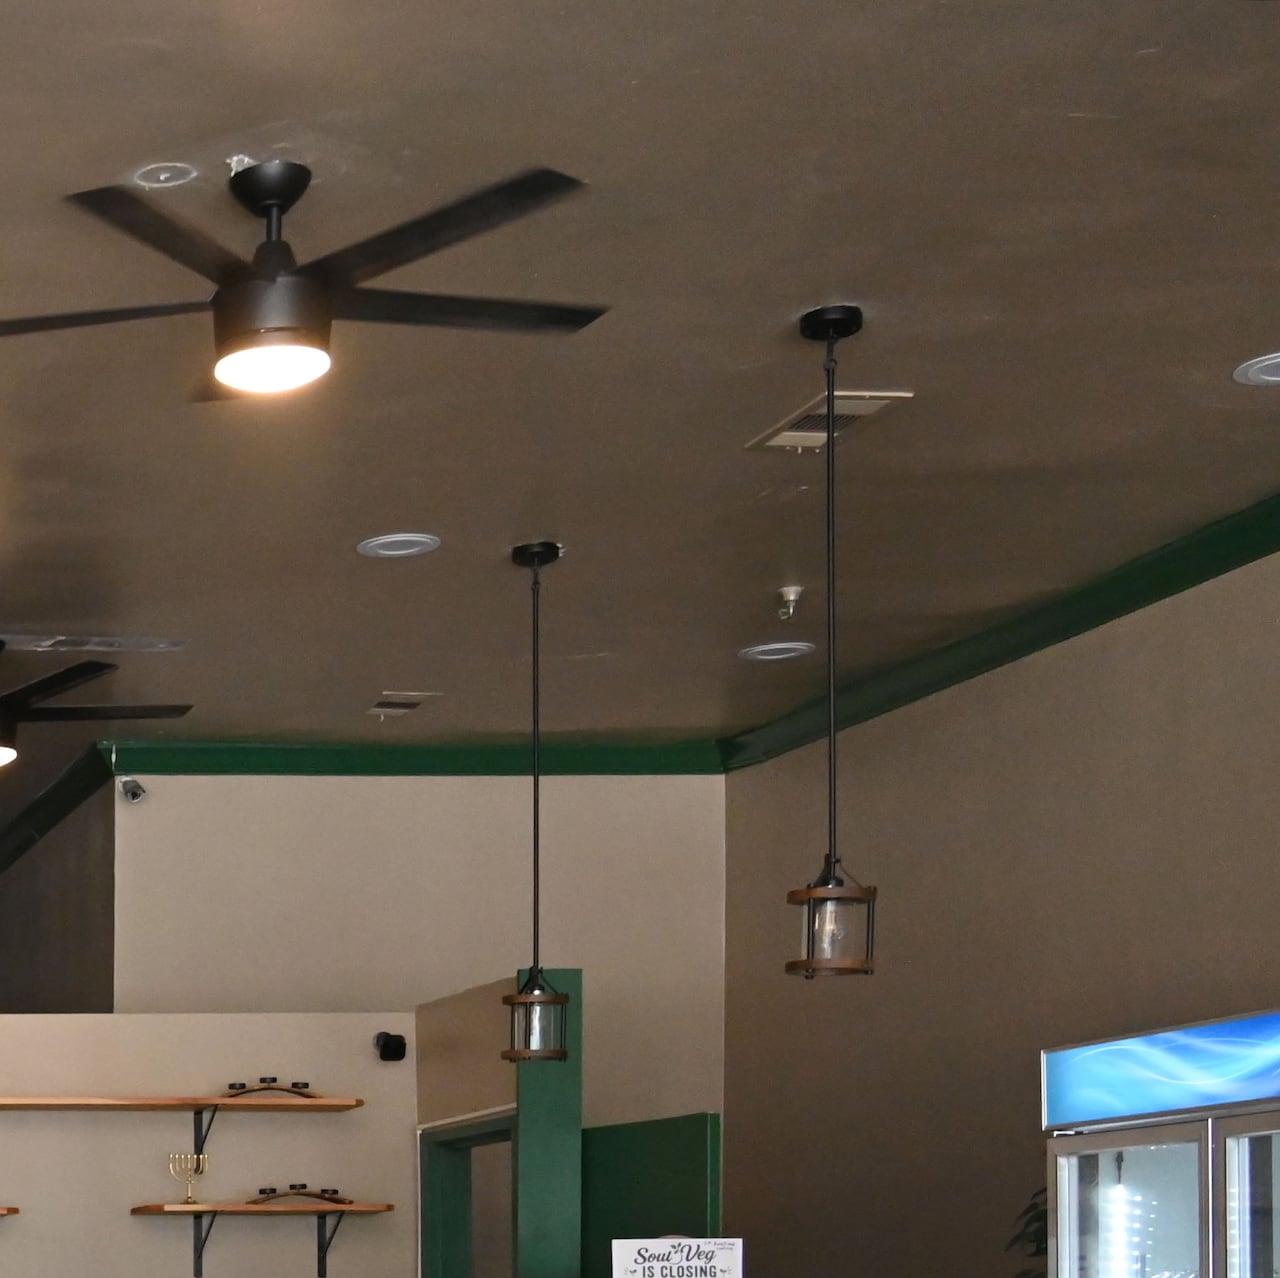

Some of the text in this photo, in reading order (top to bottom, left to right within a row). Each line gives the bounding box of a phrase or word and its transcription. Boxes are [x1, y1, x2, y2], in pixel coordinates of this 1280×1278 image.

[634, 1247, 672, 1265] Soul
[680, 1243, 716, 1265] Veg
[642, 1265, 717, 1278] IS CLOSING
